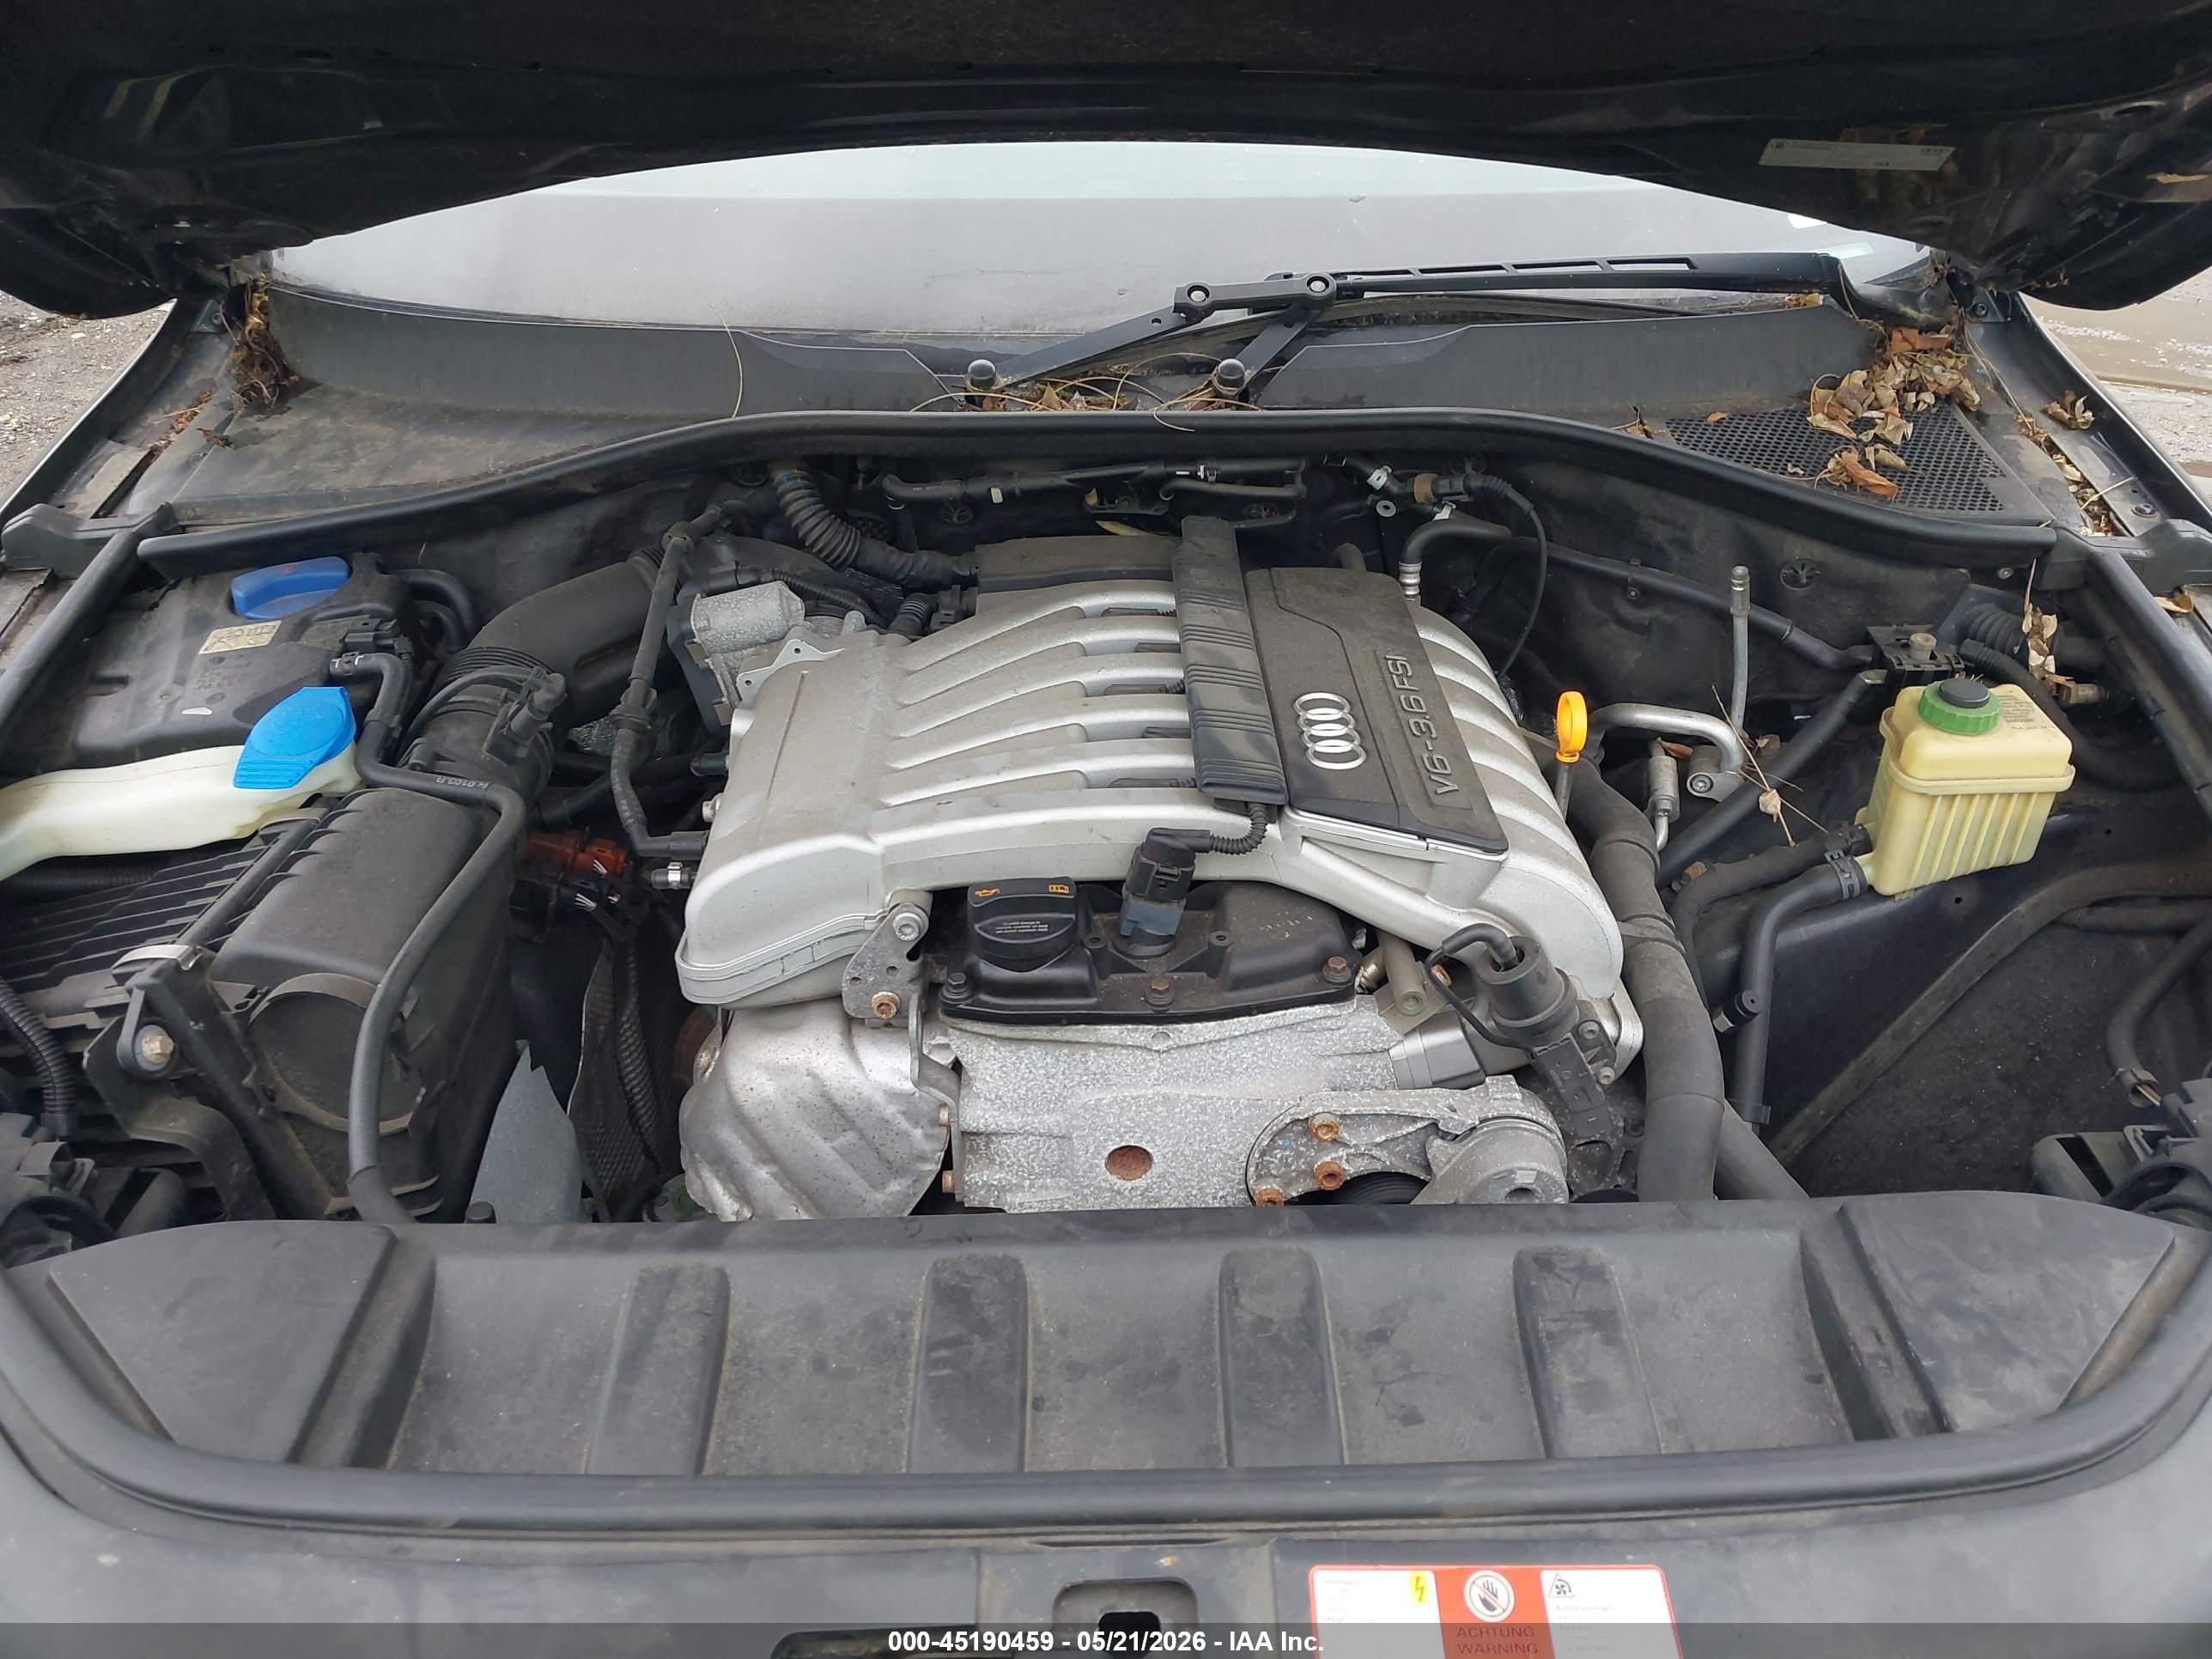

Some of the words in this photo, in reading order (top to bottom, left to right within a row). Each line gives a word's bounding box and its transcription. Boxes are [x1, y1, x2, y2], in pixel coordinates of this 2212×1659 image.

[1383, 654, 1419, 692] FSI
[1456, 1626, 1534, 1638] ACHTUNG
[1456, 1641, 1538, 1654] WARNING
